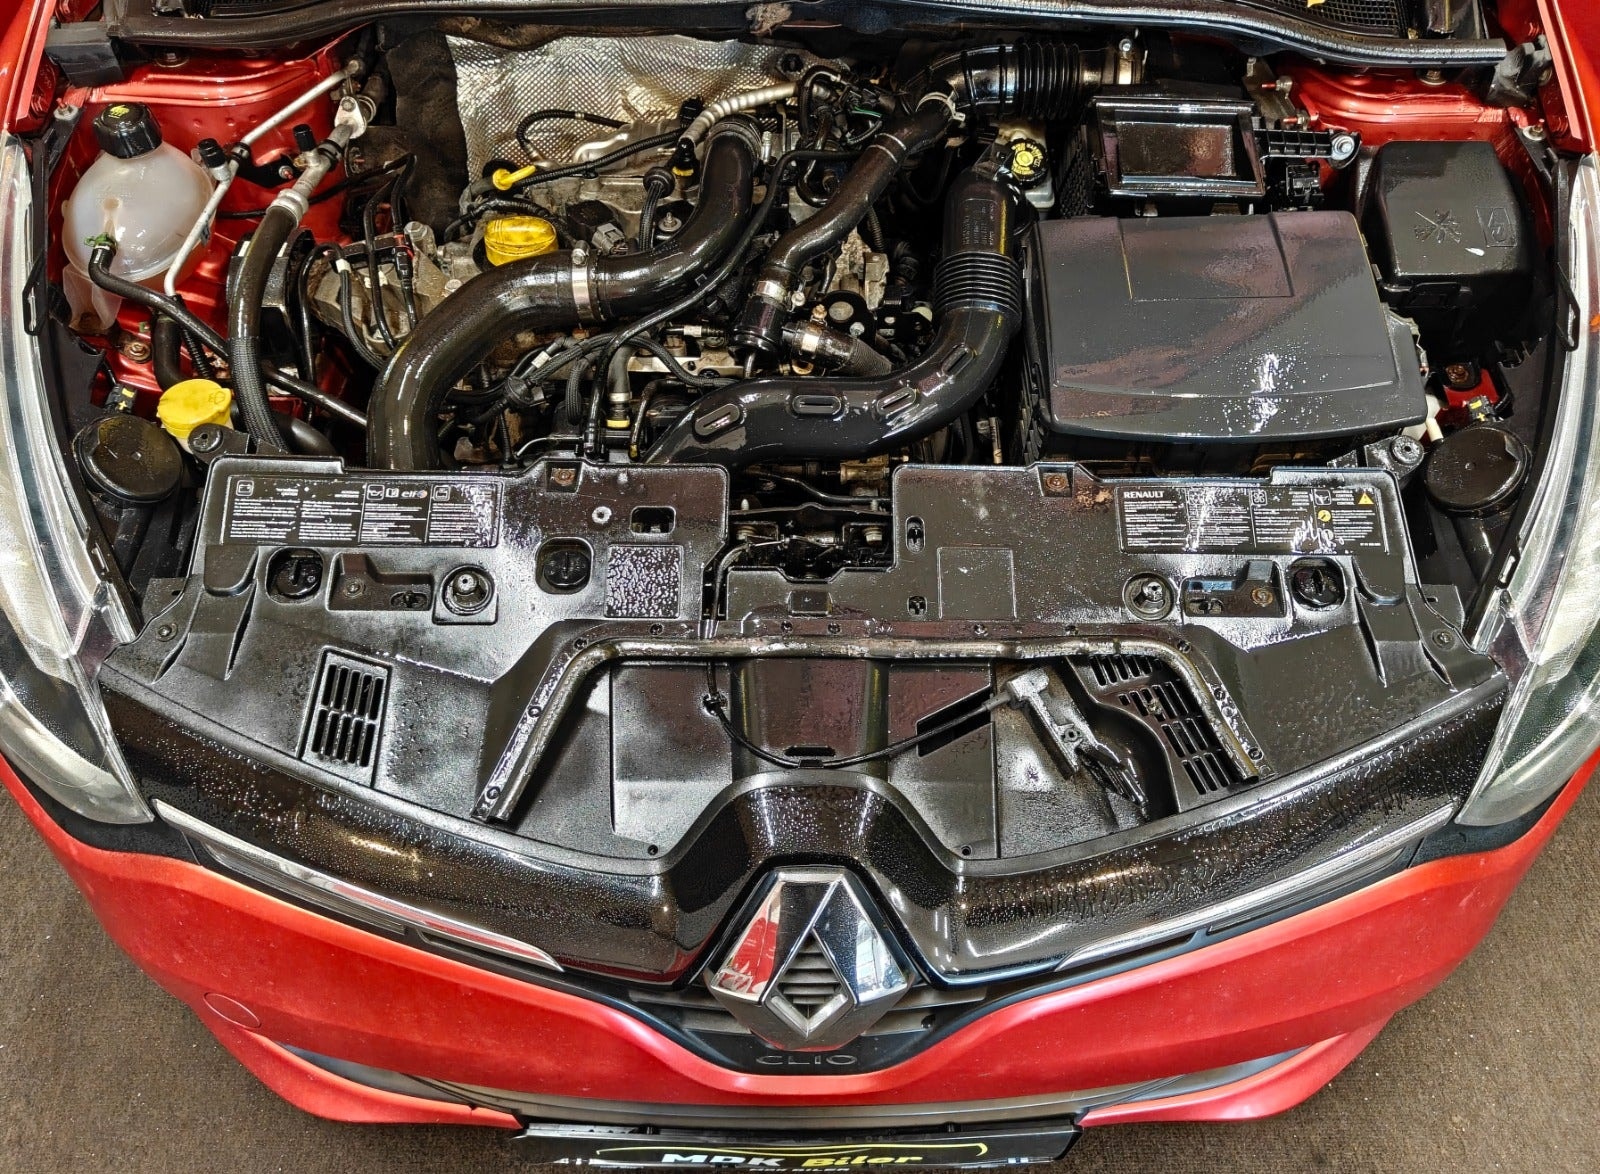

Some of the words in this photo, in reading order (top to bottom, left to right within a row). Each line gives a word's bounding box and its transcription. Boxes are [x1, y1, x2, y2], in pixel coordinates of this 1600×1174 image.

[401, 490, 418, 498] elf
[1123, 490, 1165, 499] RENAULT
[756, 1054, 857, 1065] CLIO
[661, 1153, 785, 1167] MDK
[801, 1155, 923, 1167] Biler
